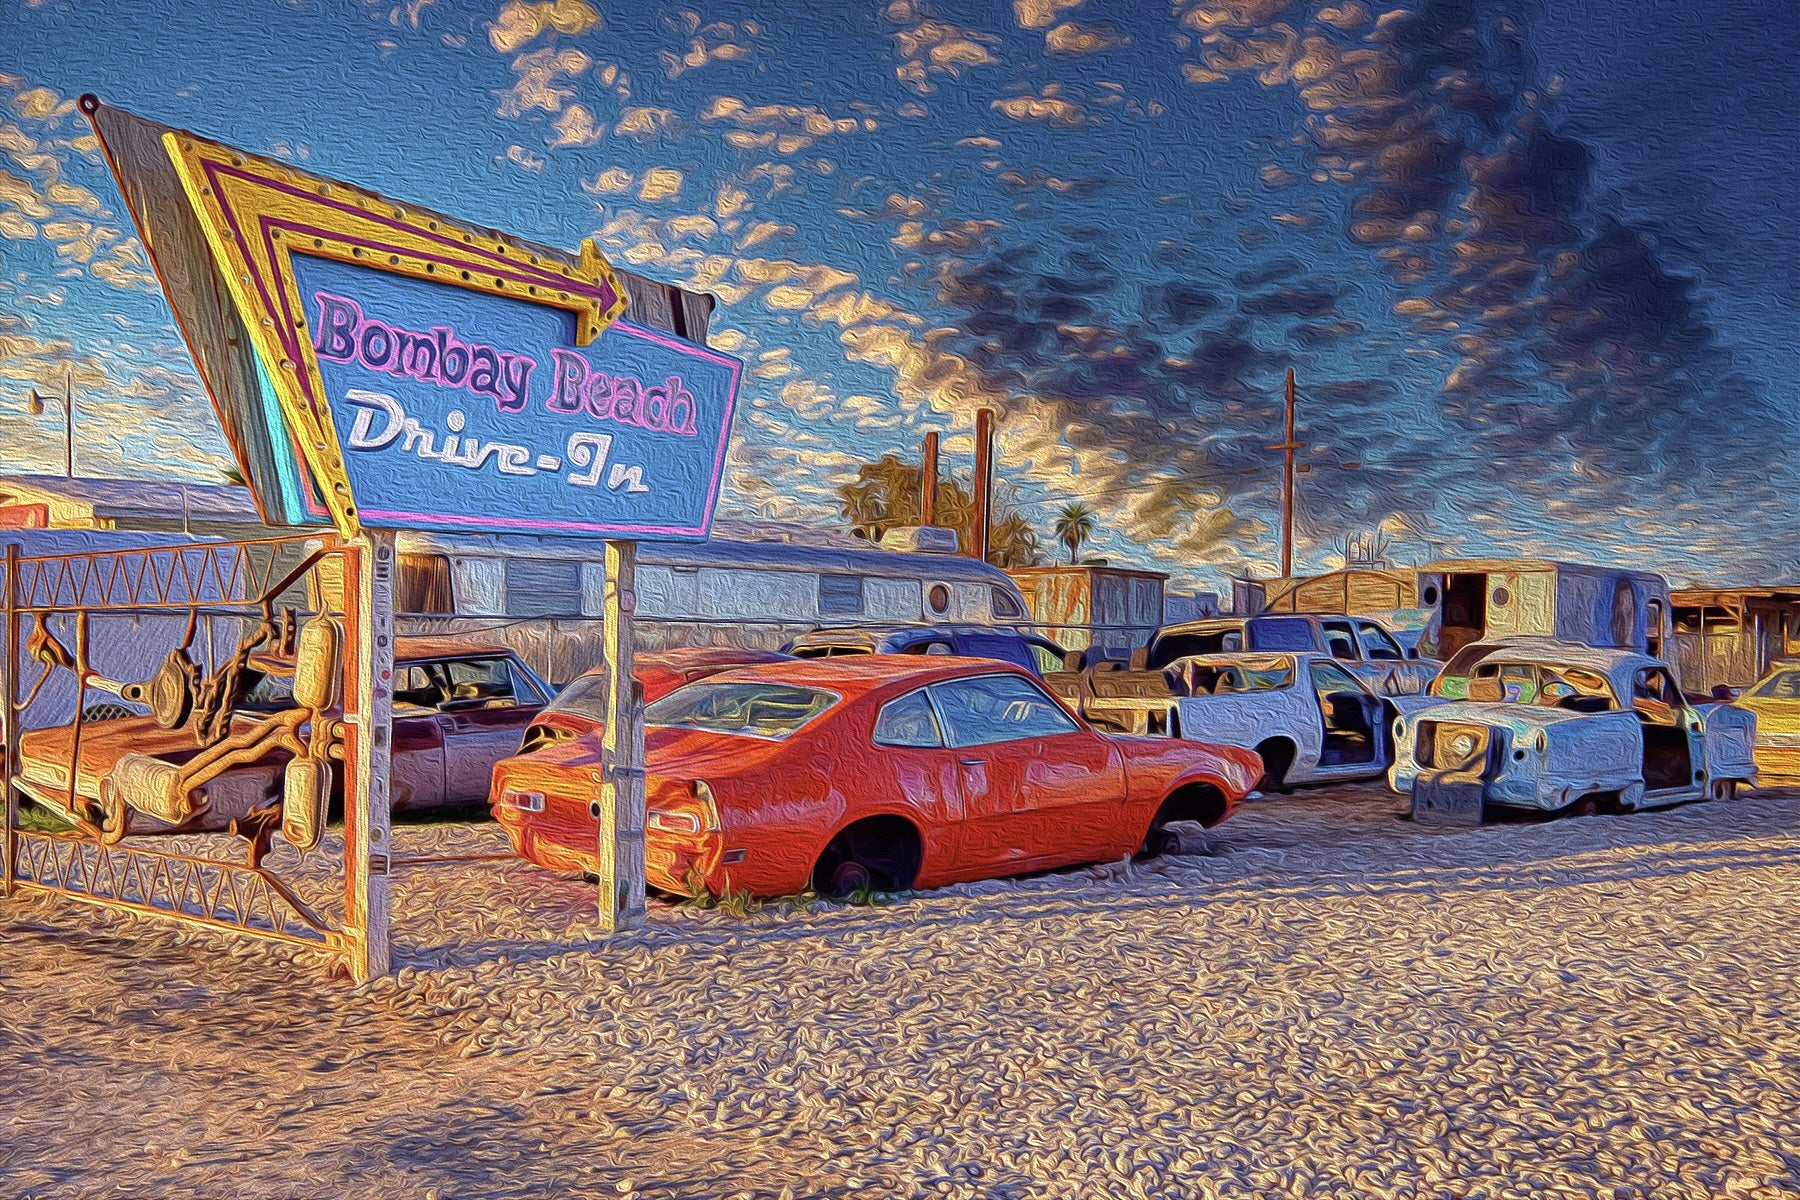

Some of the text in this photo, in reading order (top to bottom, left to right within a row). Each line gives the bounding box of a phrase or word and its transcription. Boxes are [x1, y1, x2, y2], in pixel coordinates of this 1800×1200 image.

[314, 292, 697, 436] Bombay Beach
[345, 388, 650, 494] Drive-In
